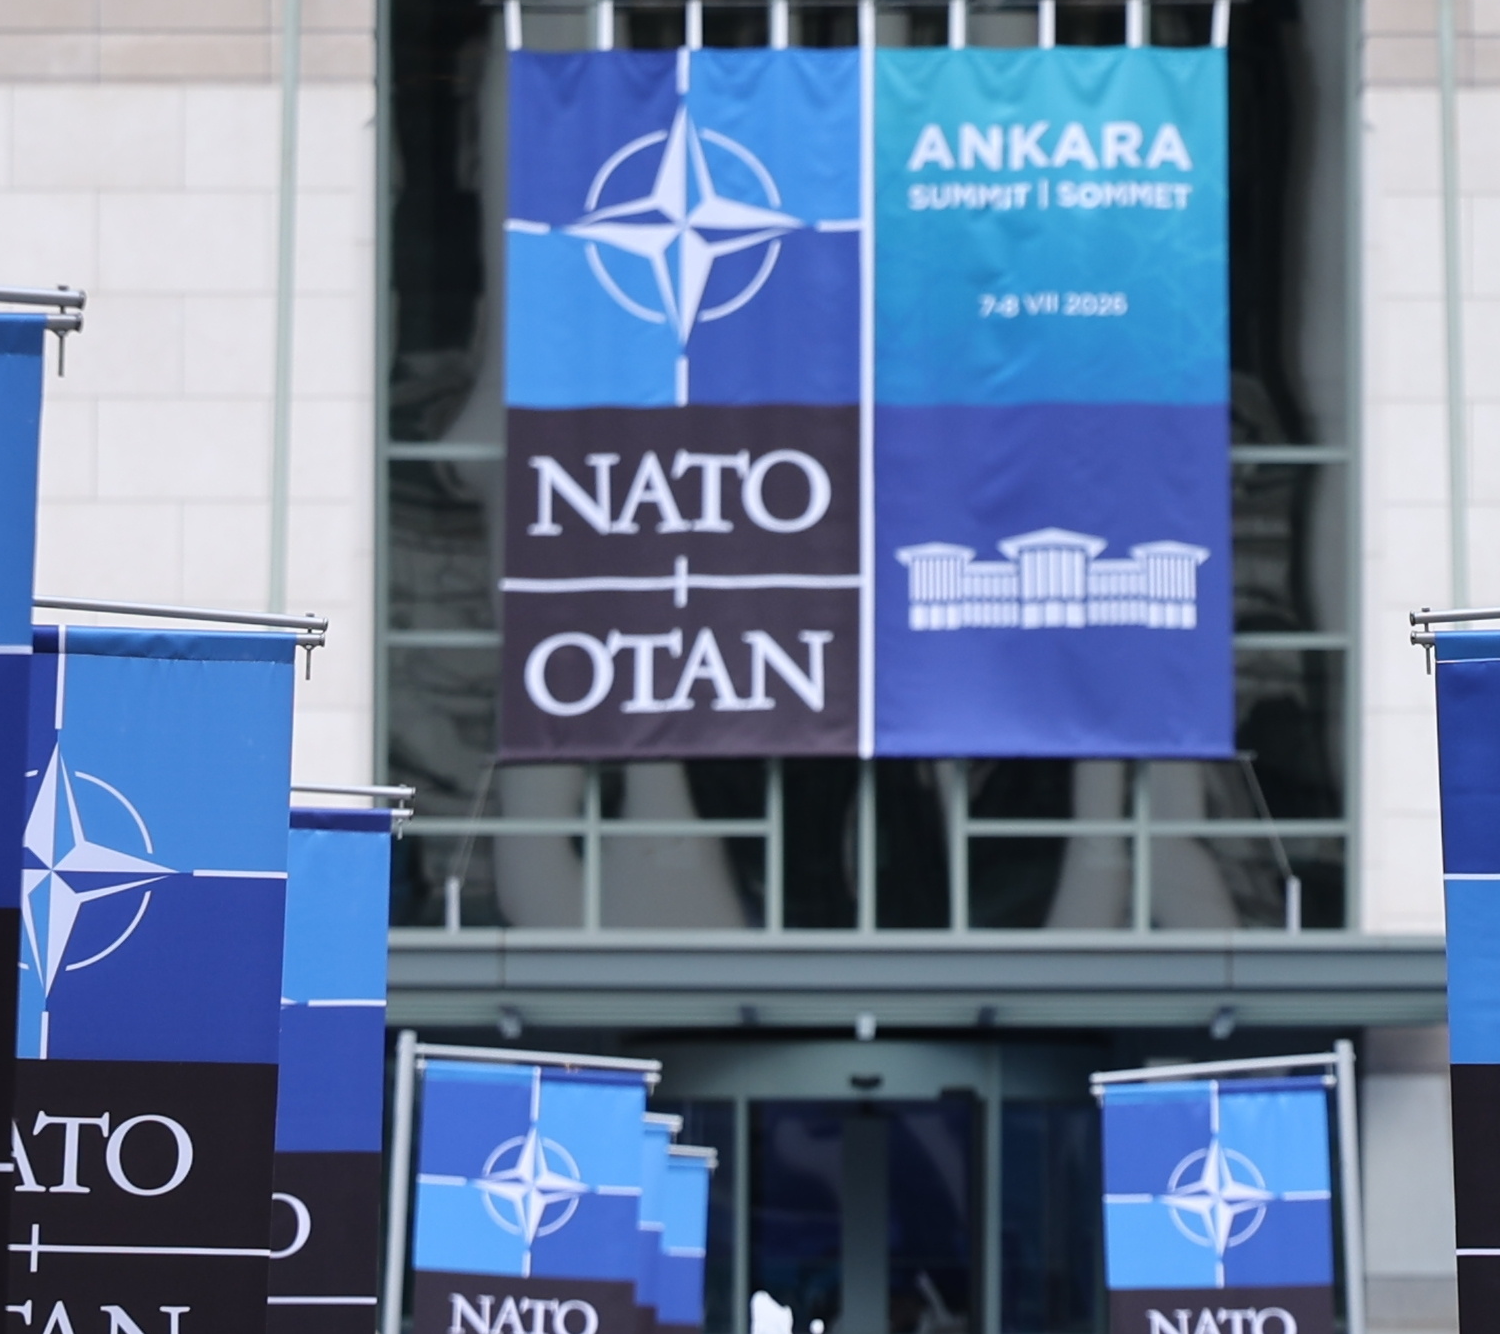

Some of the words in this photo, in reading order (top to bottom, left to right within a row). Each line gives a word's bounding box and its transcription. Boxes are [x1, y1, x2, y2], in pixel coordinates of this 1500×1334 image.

[909, 121, 1192, 171] ANKARA
[909, 182, 1032, 210] SUMMIT
[1057, 181, 1192, 209] SOMMET
[531, 450, 831, 535] NATO
[525, 629, 832, 716] OTAN
[11, 1111, 193, 1196] TO
